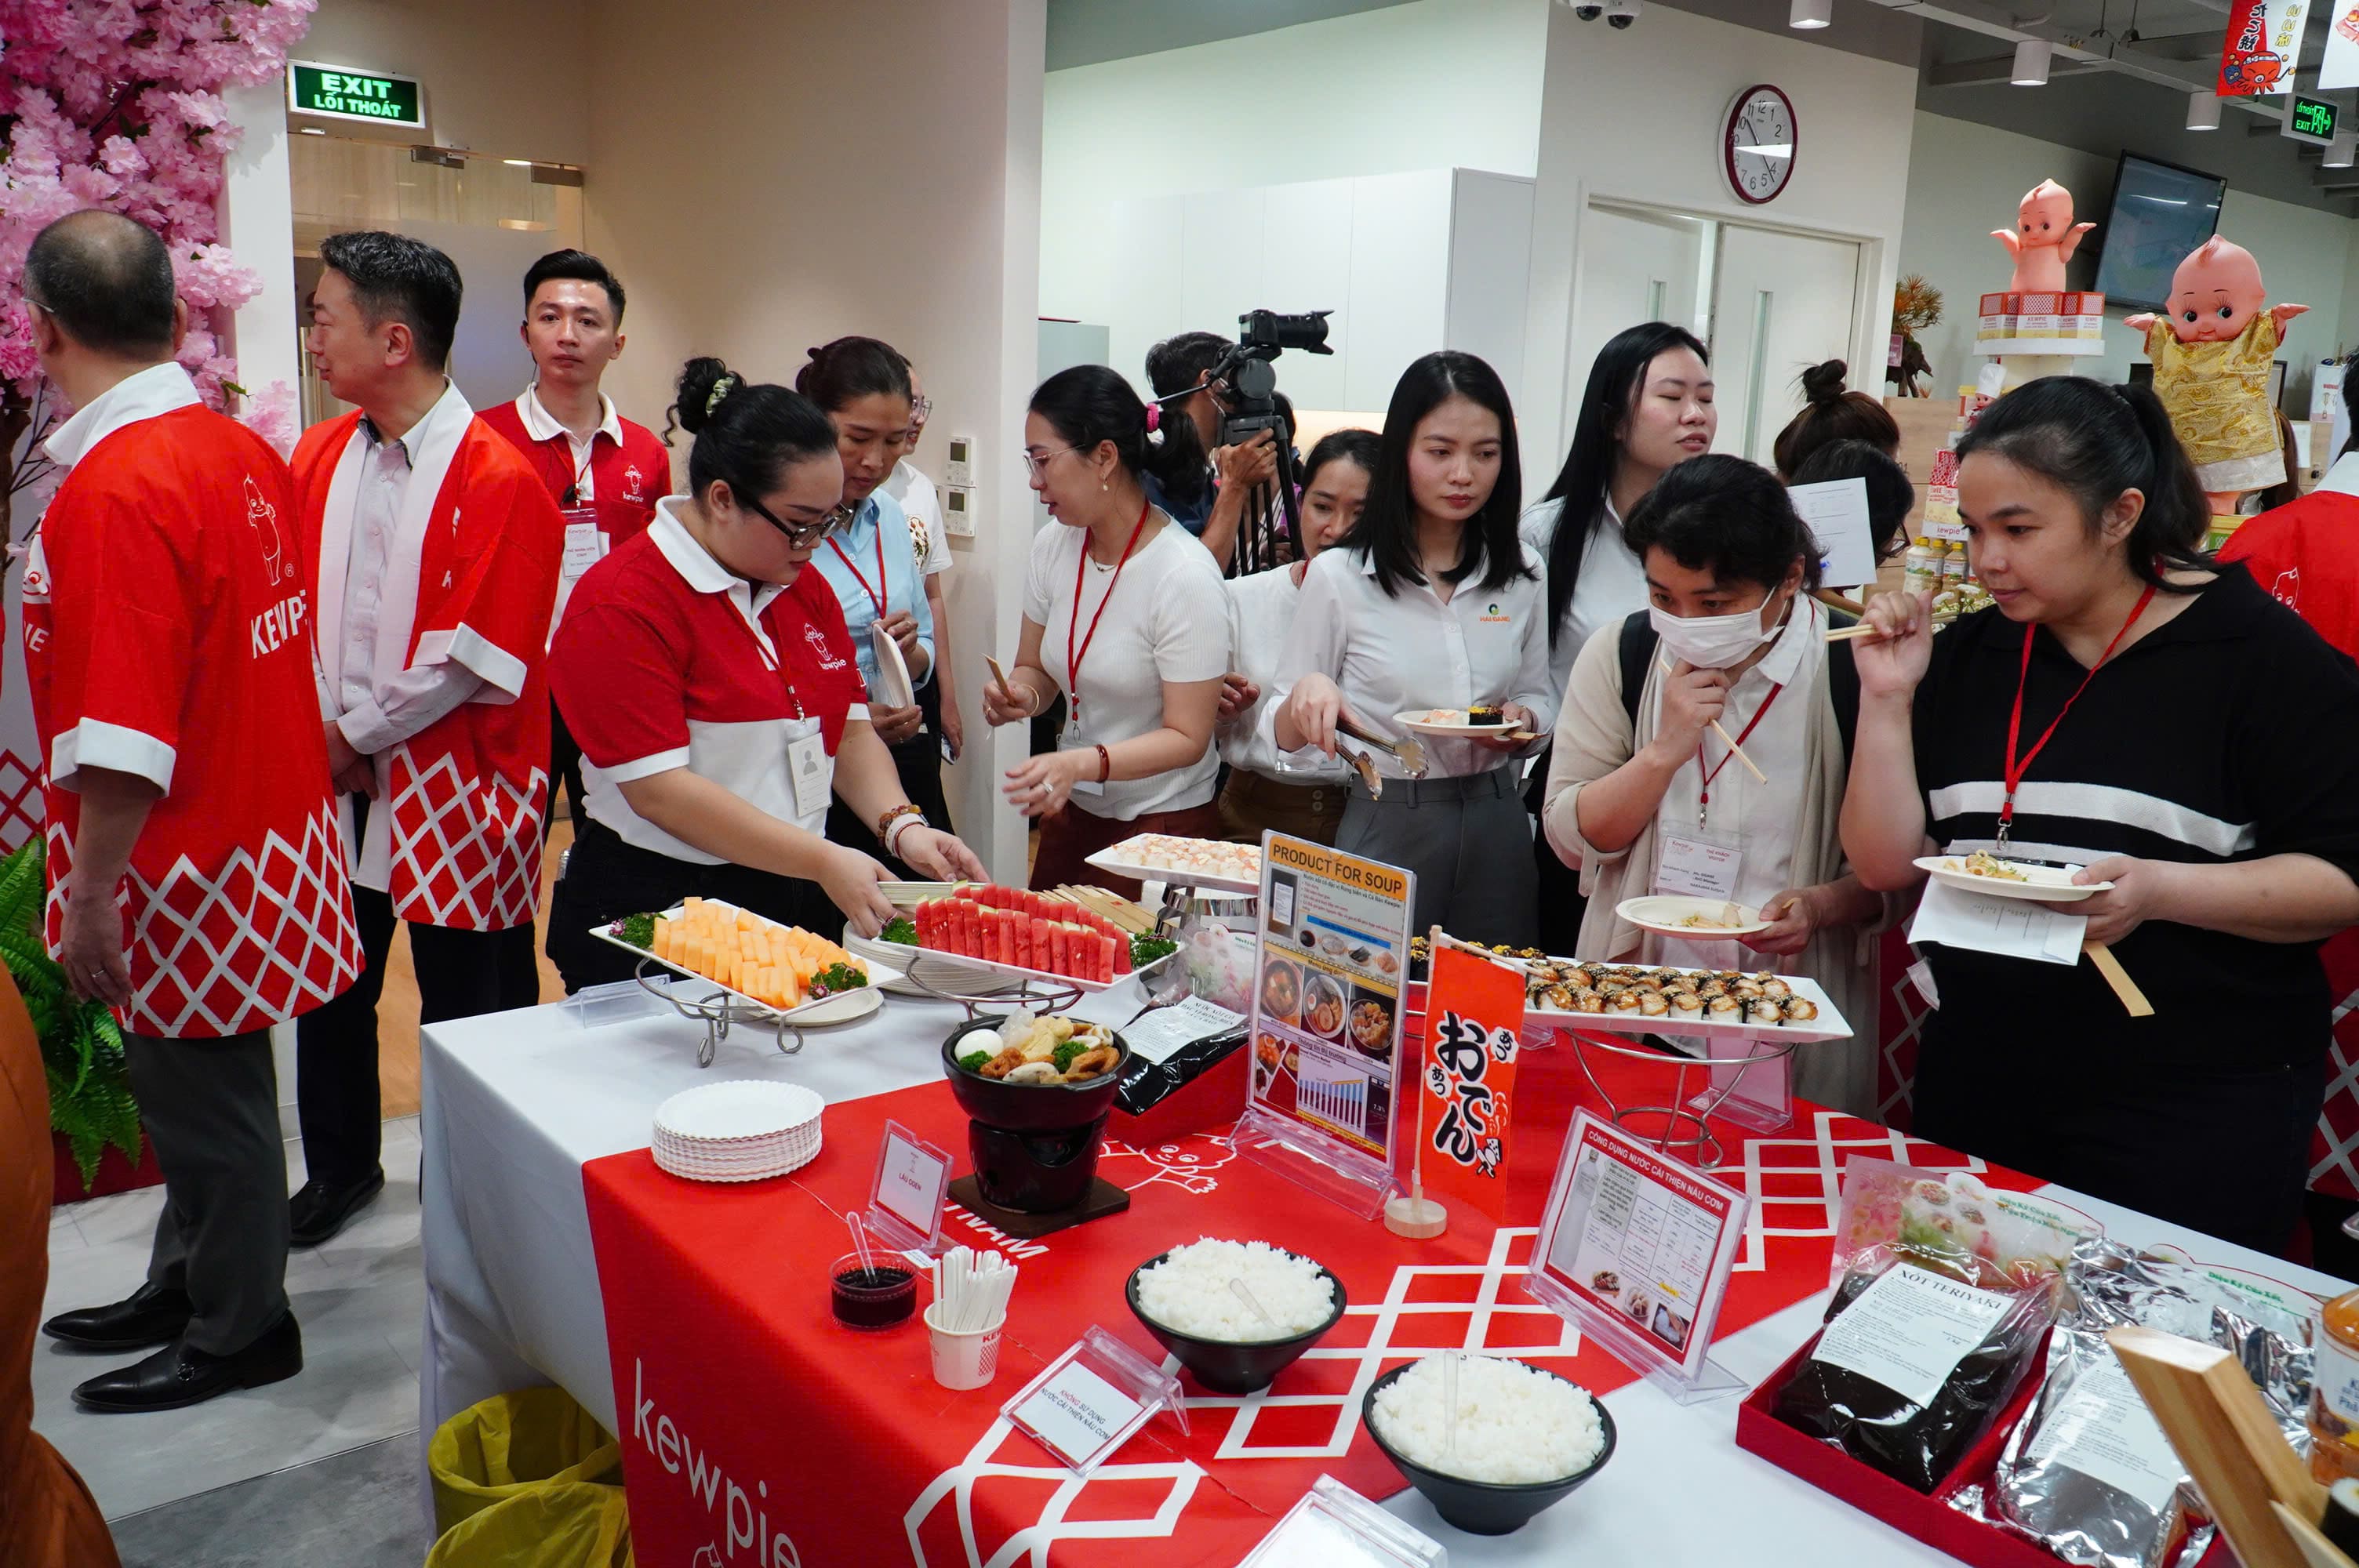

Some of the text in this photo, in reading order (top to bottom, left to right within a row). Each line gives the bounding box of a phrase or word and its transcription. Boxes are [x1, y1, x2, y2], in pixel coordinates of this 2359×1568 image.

[321, 73, 391, 98] EXIT
[314, 90, 402, 118] LỐI THOÁT
[1747, 103, 1754, 117] 11
[1738, 115, 1747, 130] 10
[1775, 124, 1782, 138] 2
[2296, 120, 2310, 131] EXIT
[1741, 169, 1747, 183] 7
[1750, 176, 1757, 190] 6
[1761, 173, 1768, 187] 5
[1937, 525, 1961, 535] kewpie
[1273, 844, 1402, 894] PRODUCT FOR SOUP
[1308, 959, 1321, 970] Menu
[1298, 1037, 1313, 1051] Thông
[1496, 1030, 1513, 1062] あつ
[1432, 1066, 1445, 1096] あつ
[1434, 1011, 1492, 1166] おでん
[1588, 1131, 1608, 1147] CÔNG
[1608, 1142, 1628, 1159] DỤNG
[1628, 1151, 1650, 1170] NƯỚC
[1651, 1163, 1664, 1178] CẢI
[1664, 1172, 1686, 1191] THIỆN
[1687, 1184, 1704, 1200] NẤU
[908, 1178, 921, 1191] ODEN
[1899, 1269, 2001, 1310] XỐT TERIYAKI
[1041, 1388, 1059, 1402] NƯỚC
[1067, 1406, 1084, 1421] THIỆN
[1084, 1417, 1096, 1430] NẤU
[1060, 1389, 1081, 1406] KHÔNG
[1088, 1409, 1106, 1425] DỤNG
[634, 1357, 801, 1568] kewpie
